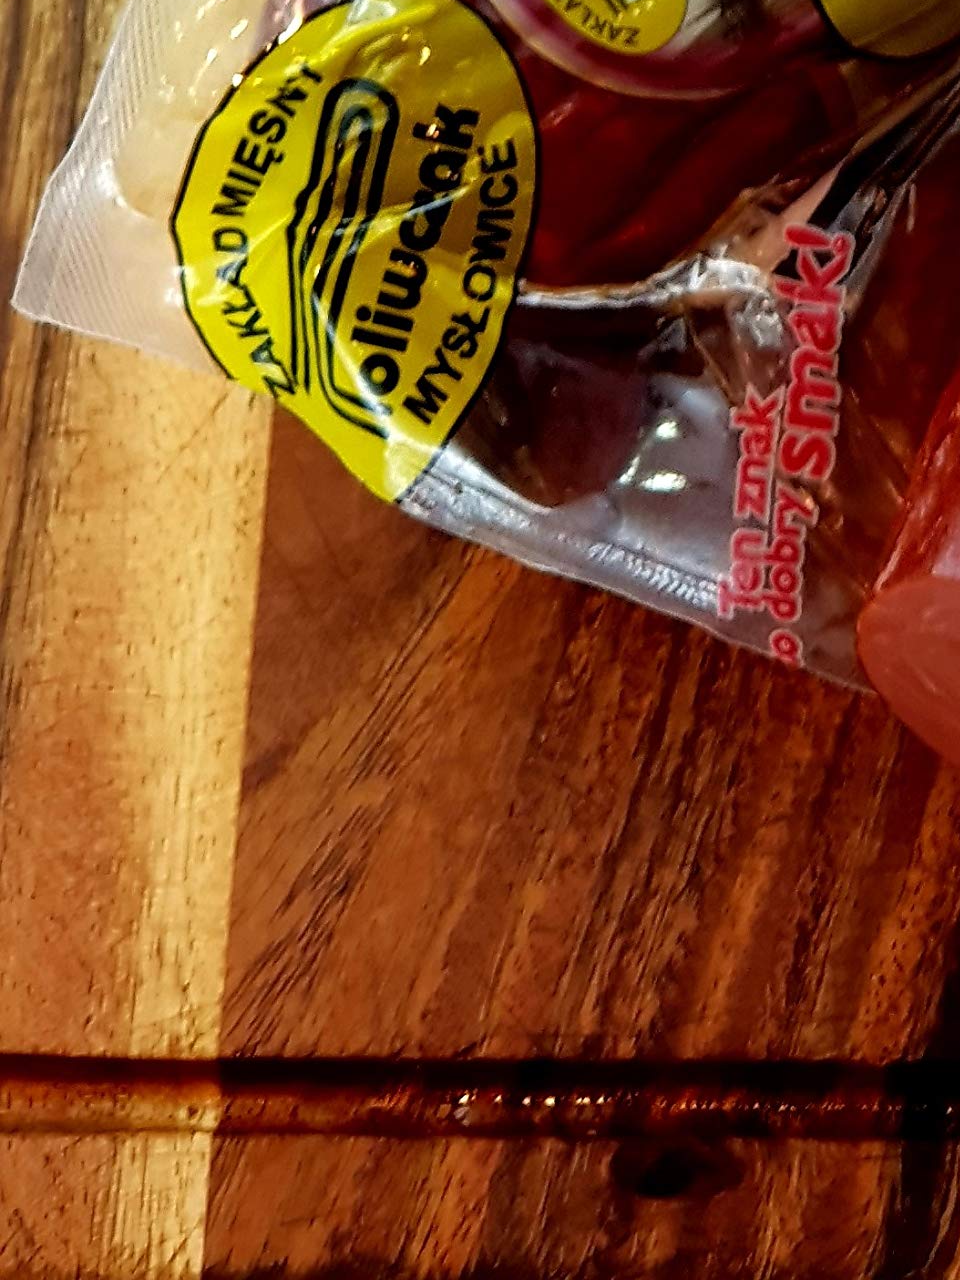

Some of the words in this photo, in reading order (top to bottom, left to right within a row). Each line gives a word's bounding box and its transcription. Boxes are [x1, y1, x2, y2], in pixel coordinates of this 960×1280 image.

[211, 63, 323, 220] MIĘSNY
[213, 228, 297, 400] ZAKŁAD
[403, 136, 519, 425] MYSŁOWICE
[774, 224, 853, 481] smak!
[730, 383, 785, 519] znak
[717, 527, 767, 619] Ten
[765, 486, 819, 621] dobry
